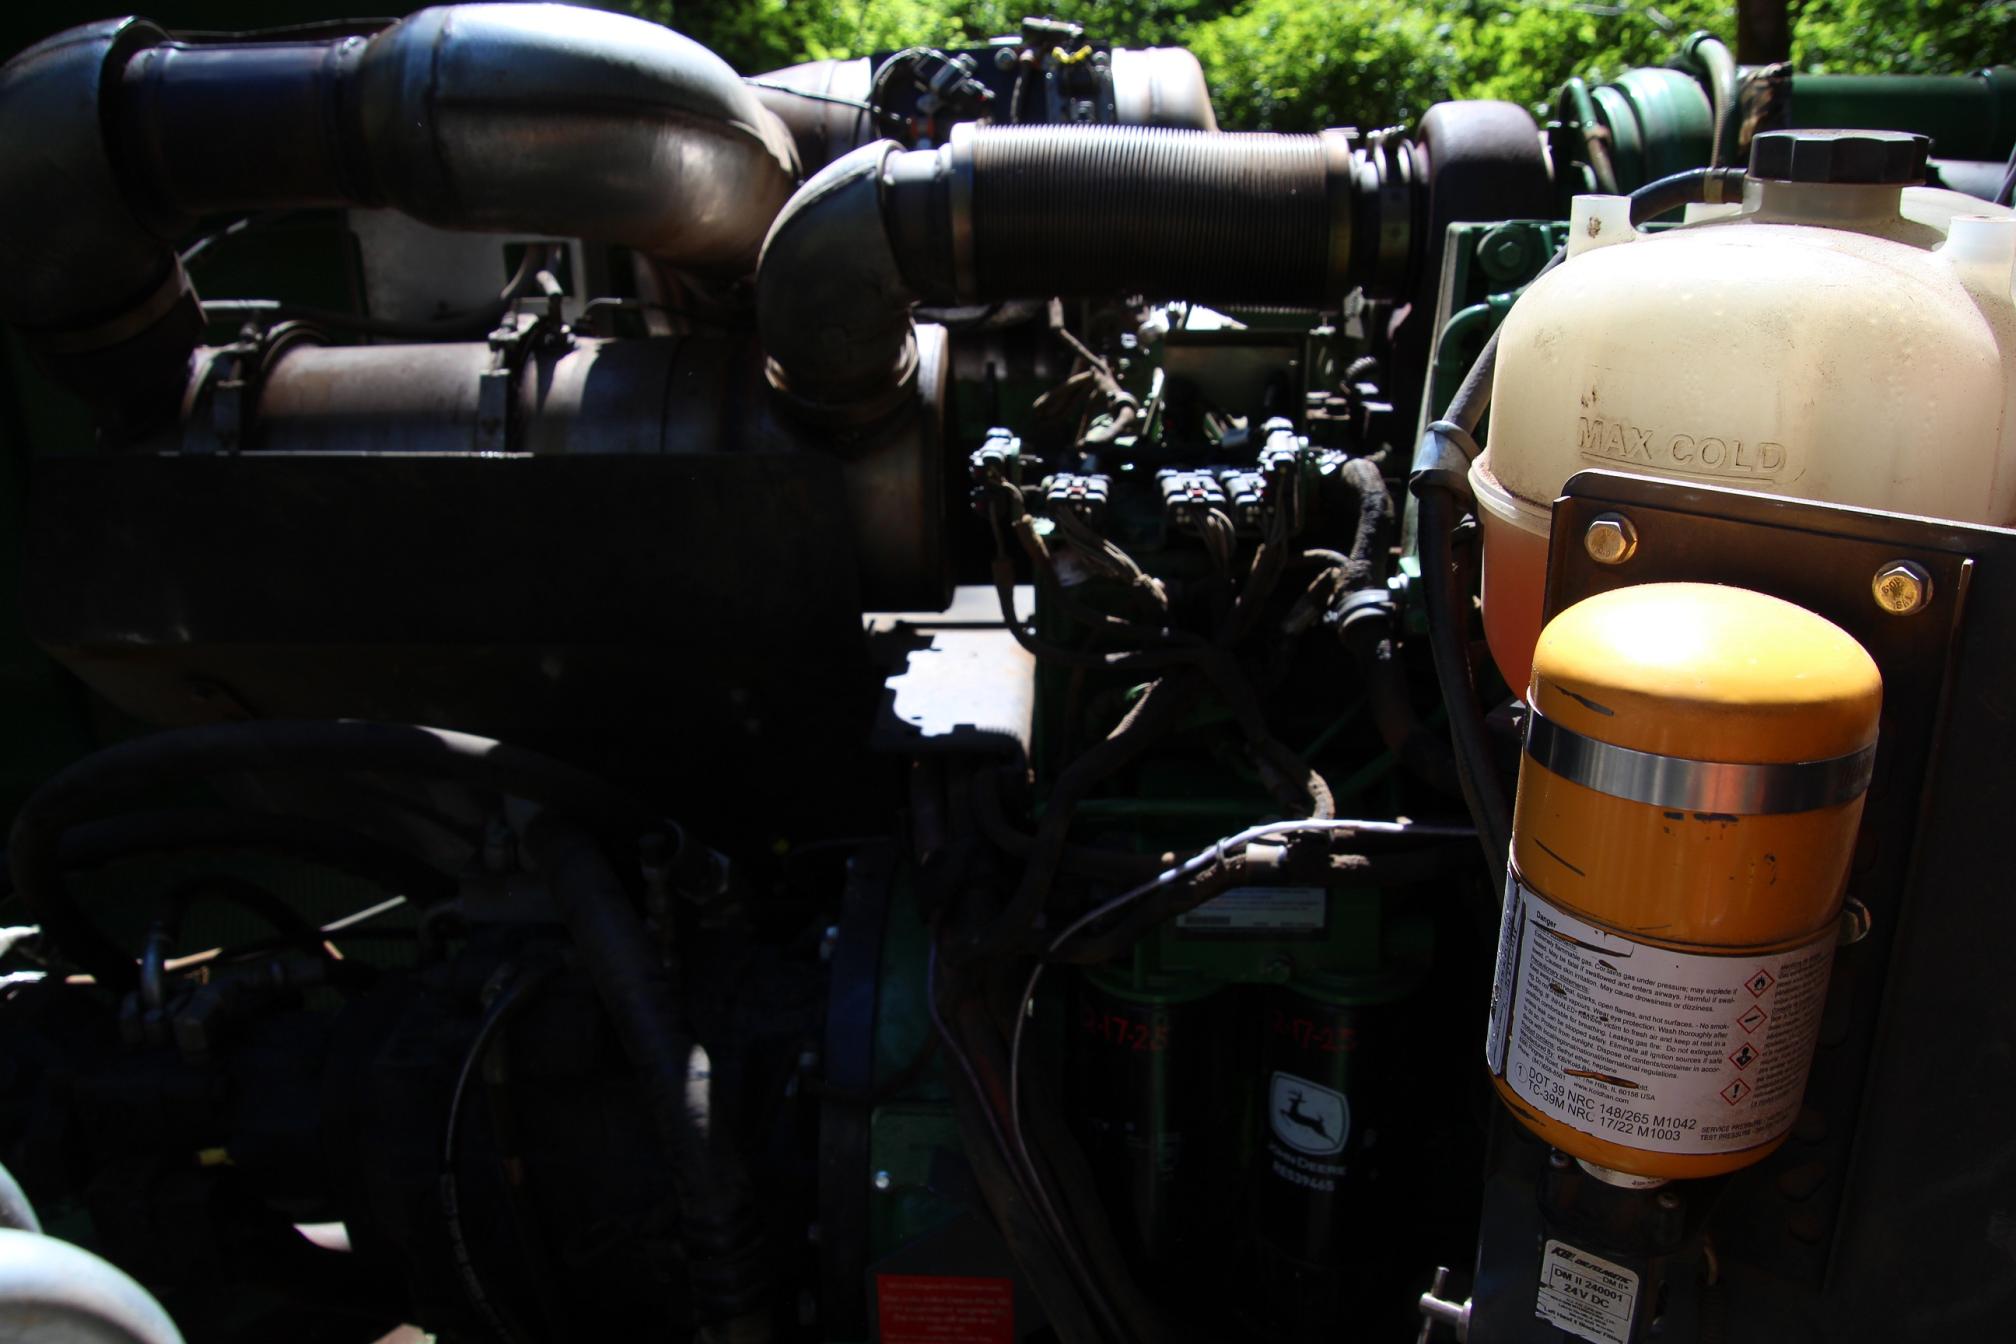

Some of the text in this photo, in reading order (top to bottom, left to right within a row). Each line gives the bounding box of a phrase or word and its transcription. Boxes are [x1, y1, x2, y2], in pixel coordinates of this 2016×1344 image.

[1579, 416, 1788, 473] MAX COLD
[1536, 910, 1556, 928] Danger
[1555, 944, 1581, 962] flammable
[1623, 973, 1634, 982] gas
[1636, 976, 1656, 986] under
[1690, 987, 1704, 995] may
[1706, 988, 1731, 996] explode
[1563, 966, 1574, 976] skin
[1599, 983, 1613, 994] May
[1614, 990, 1634, 999] cause
[1635, 994, 1672, 1006] drowsiness
[1567, 960, 1579, 970] fatal
[1585, 968, 1616, 984] swallowed
[1618, 980, 1630, 990] and
[1632, 985, 1652, 995] enters
[1654, 990, 1681, 1000] airways.
[1684, 995, 1711, 1003] Harmful
[1576, 991, 1596, 1005] sparks,
[1598, 1001, 1614, 1012] open
[1615, 1006, 1637, 1019] flames,
[1638, 1014, 1652, 1022] and
[1652, 1016, 1663, 1024] hot
[1593, 1006, 1609, 1017] Wear
[1610, 1015, 1622, 1024] eye
[1622, 1018, 1656, 1032] protection.
[1658, 1026, 1677, 1034] Wash
[1678, 1030, 1712, 1040] thoroughly
[1558, 1026, 1571, 1038] from
[1596, 1045, 1623, 1060] Dispose
[1632, 1056, 1692, 1072] contents/container
[1565, 1020, 1588, 1038] stopped
[1610, 1040, 1638, 1054] Eliminate
[1650, 1052, 1674, 1061] ignition
[1570, 1016, 1578, 1024] for
[1609, 1032, 1634, 1046] Leaking
[1636, 1040, 1648, 1048] gas
[1604, 1022, 1622, 1032] victim
[1631, 1029, 1648, 1038] fresh
[1674, 1038, 1691, 1046] keep
[1592, 1060, 1618, 1074] heptane
[1529, 1066, 1550, 1087] DOT
[1552, 1082, 1566, 1097] 39
[1568, 1090, 1595, 1110] NRC
[1600, 1104, 1650, 1125] 148/265
[1653, 1115, 1697, 1130] M1042
[1529, 1078, 1681, 1141] TC-39M NRC 17/22 M1003
[1701, 1126, 1732, 1134] SERVICE
[1554, 1268, 1622, 1302] DM II 240001
[1602, 1276, 1618, 1287] DM
[1592, 1294, 1610, 1309] DC
